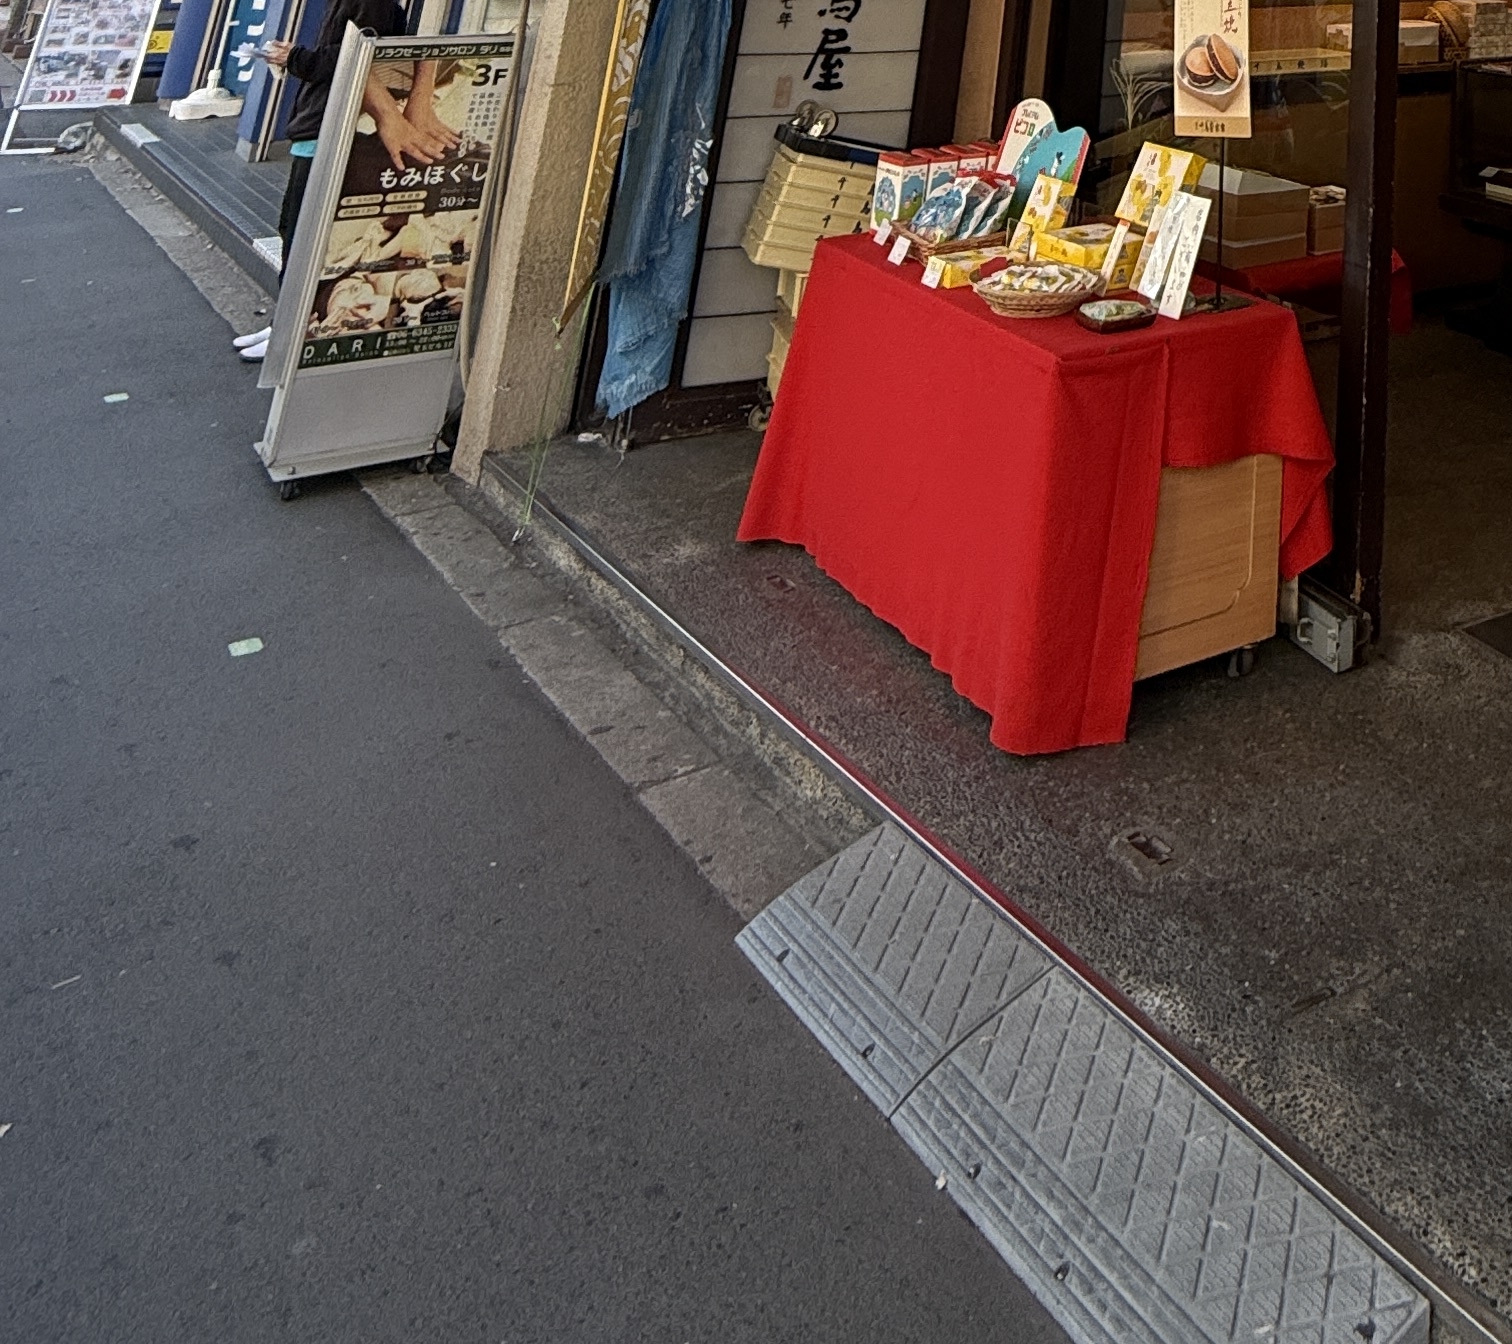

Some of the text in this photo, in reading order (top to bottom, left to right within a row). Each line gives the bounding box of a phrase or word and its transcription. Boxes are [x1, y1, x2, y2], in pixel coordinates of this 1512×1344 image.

[375, 45, 477, 59] リラクゼーションサロン
[471, 63, 509, 87] 3F
[380, 162, 487, 189] もみほぐし
[302, 336, 383, 360] DARI
